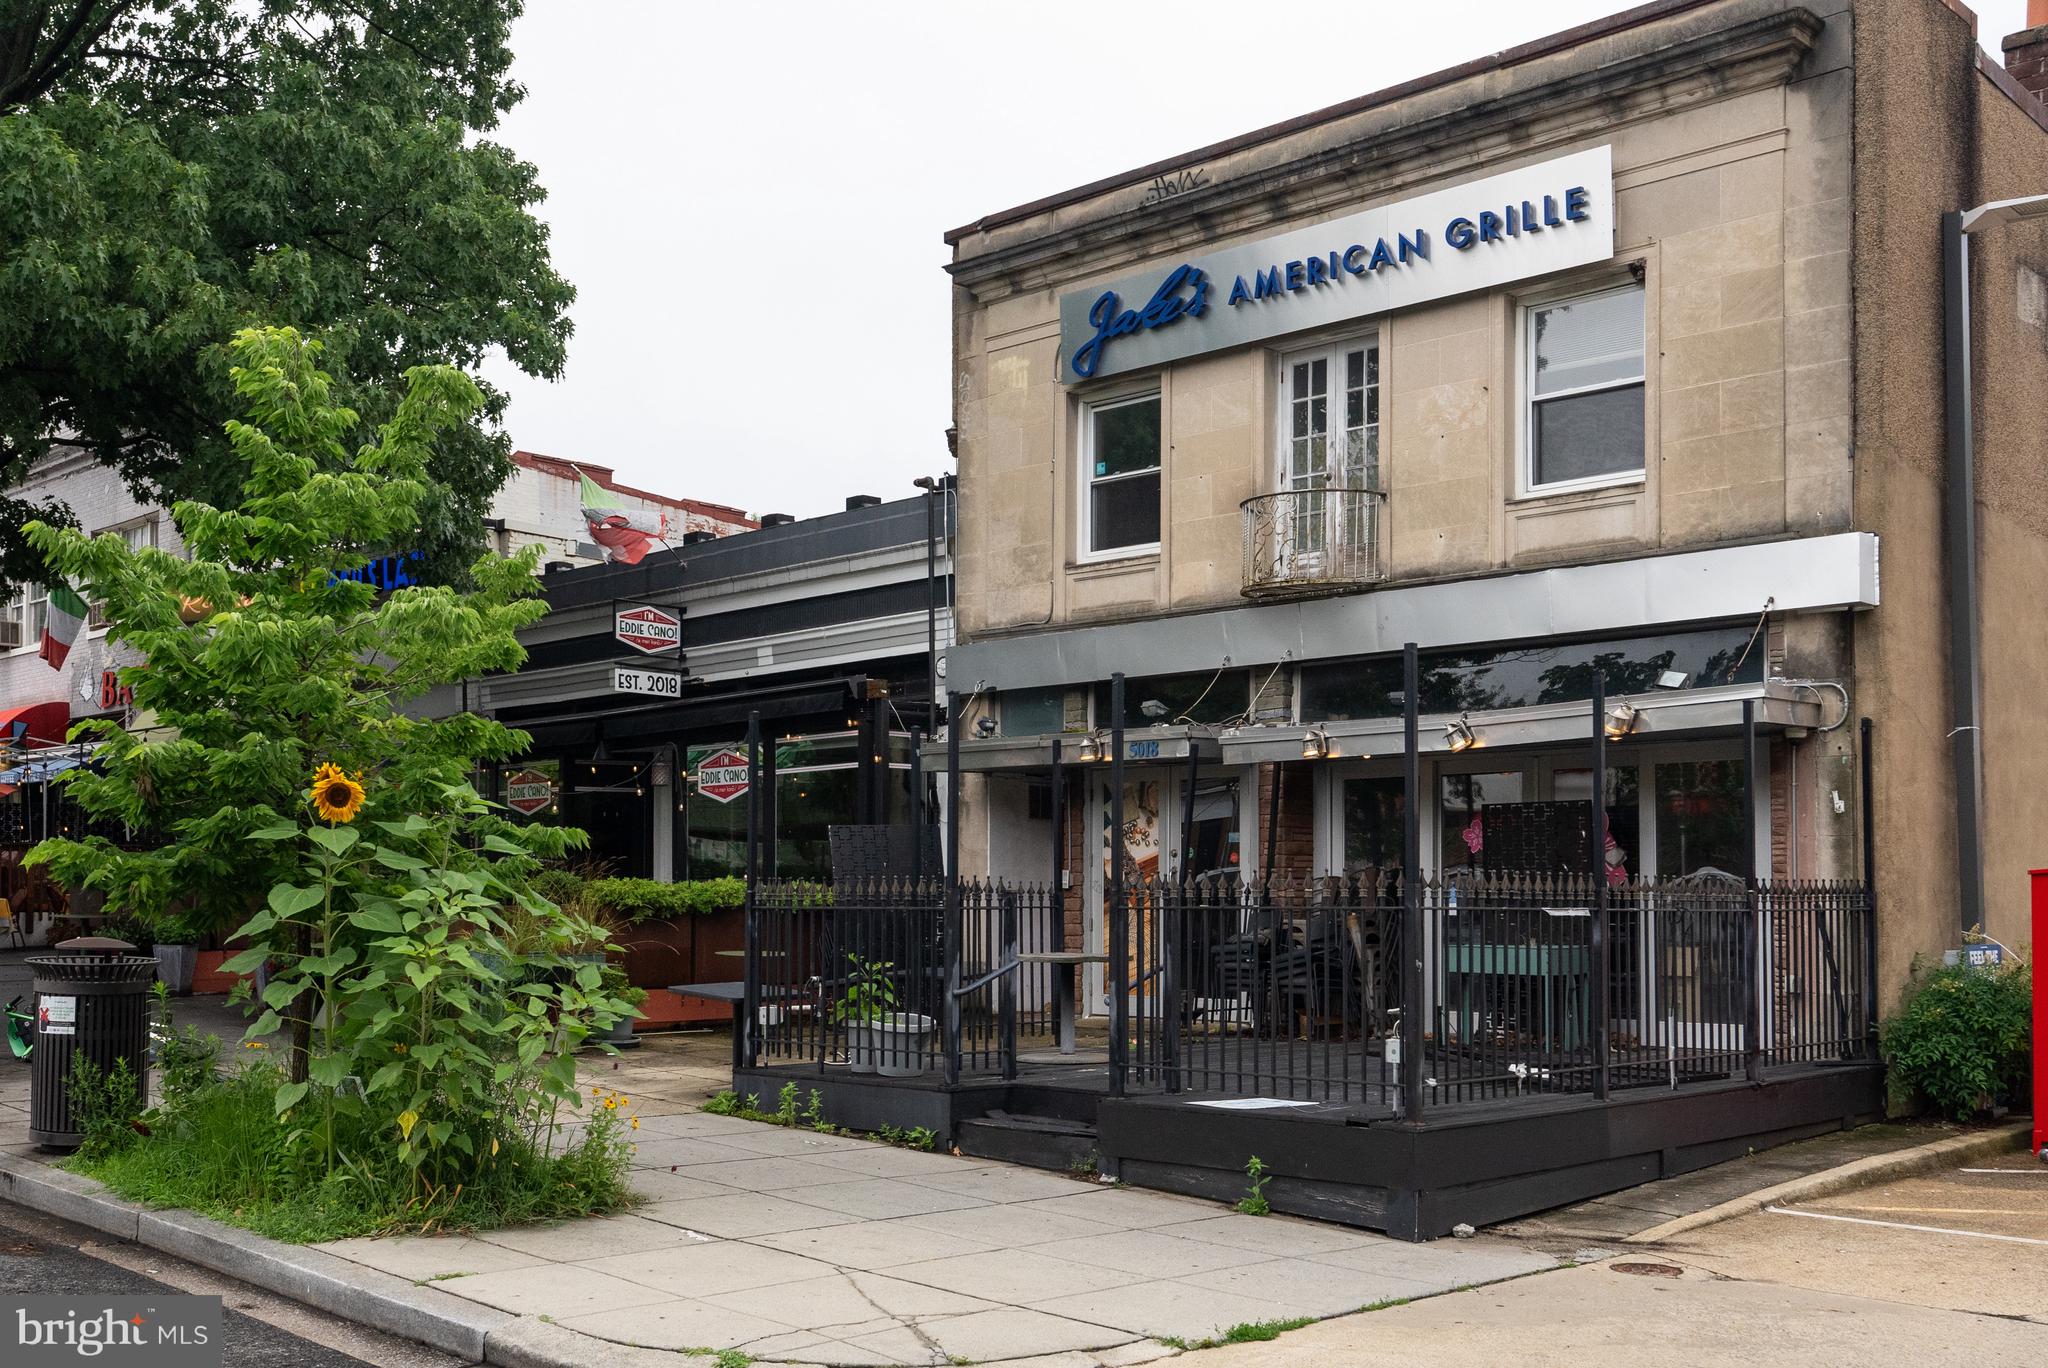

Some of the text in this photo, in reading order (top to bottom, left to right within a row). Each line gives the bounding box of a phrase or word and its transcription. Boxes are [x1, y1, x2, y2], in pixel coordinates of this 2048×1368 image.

[1071, 186, 1587, 378] Jake's AMERICAN GRILLE
[619, 619, 678, 640] EDDIE CANO!
[618, 673, 678, 694] EST. 2018
[1128, 740, 1160, 759] 5018
[700, 770, 721, 785] EDDIE
[1969, 950, 1985, 965] FEEL
